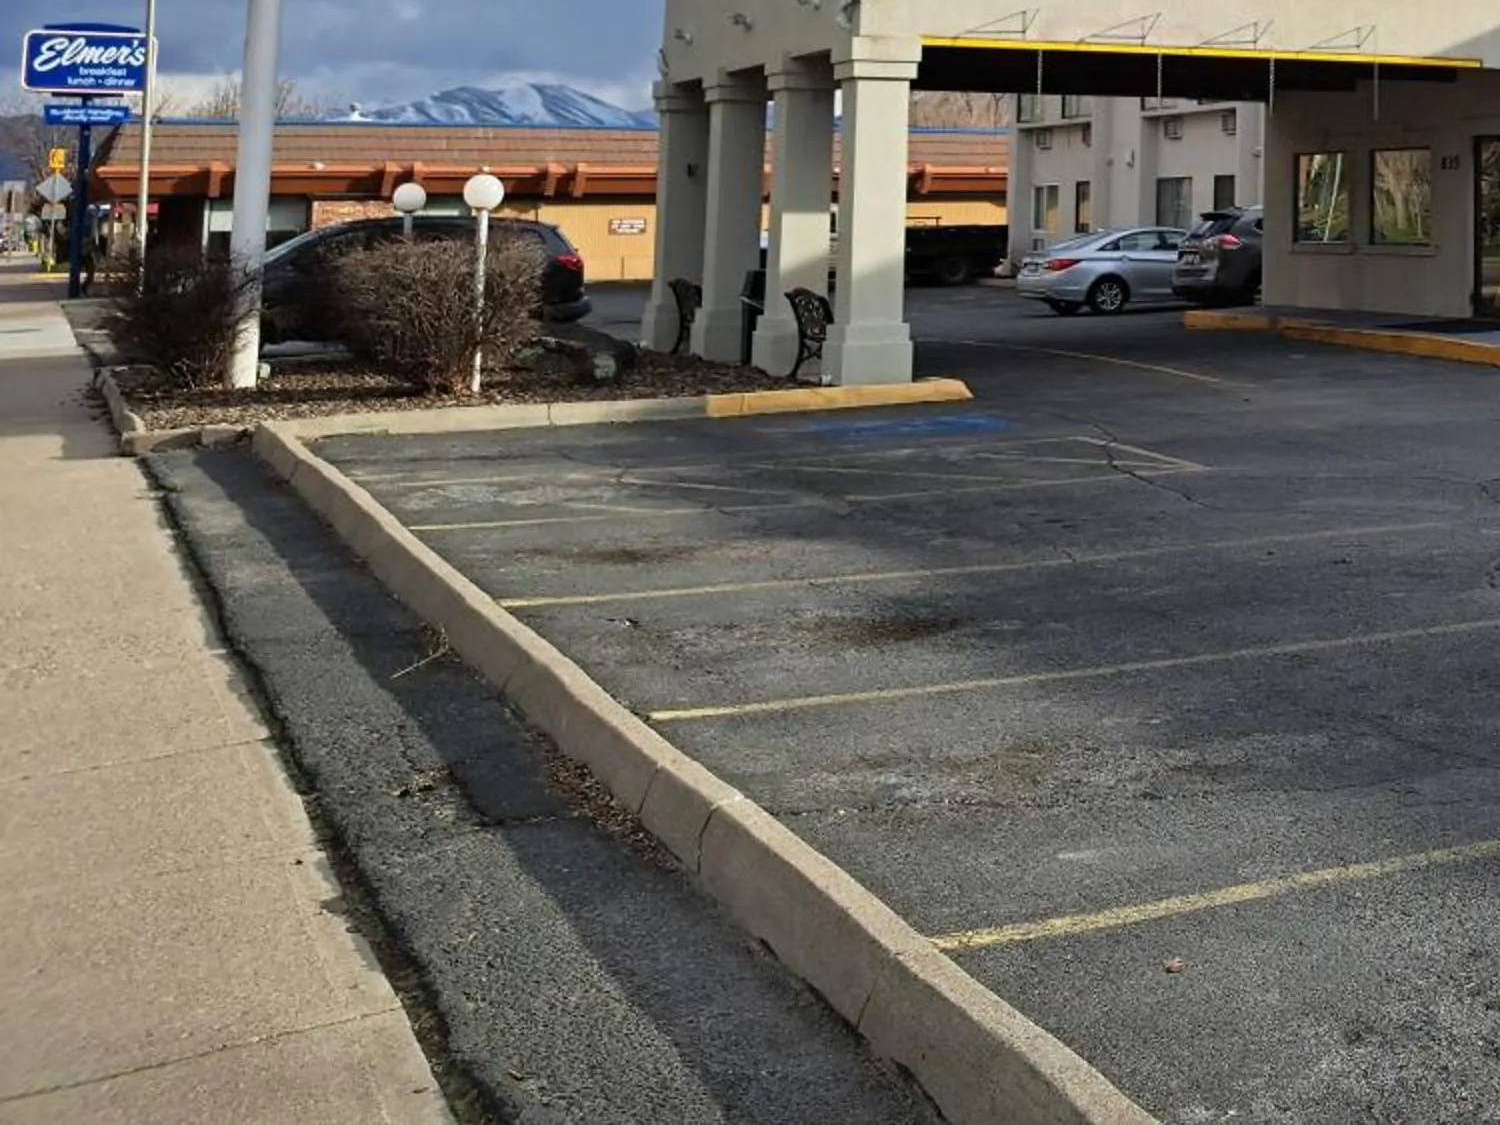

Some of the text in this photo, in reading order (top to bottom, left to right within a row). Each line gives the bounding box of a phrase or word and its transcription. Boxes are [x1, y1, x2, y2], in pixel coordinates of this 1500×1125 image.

[33, 37, 146, 72] Elmer's
[79, 66, 128, 77] breakfast
[67, 76, 136, 87] lunch dinner
